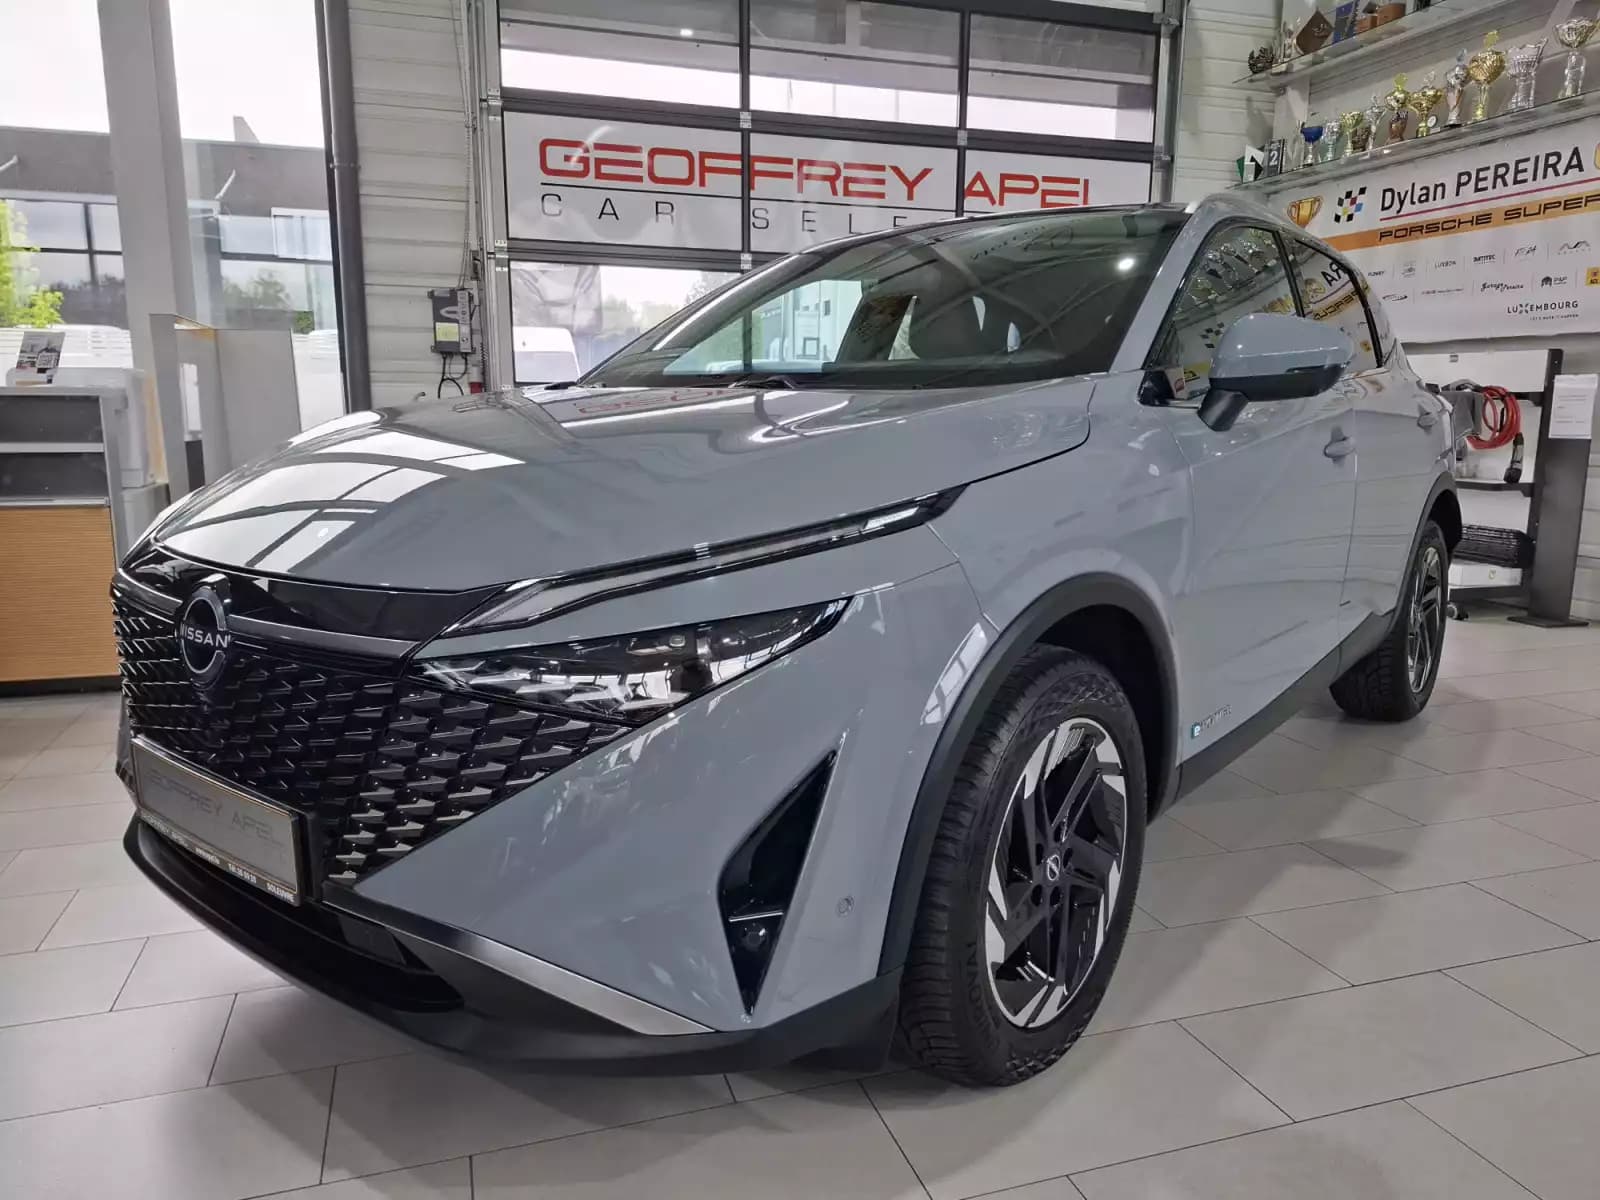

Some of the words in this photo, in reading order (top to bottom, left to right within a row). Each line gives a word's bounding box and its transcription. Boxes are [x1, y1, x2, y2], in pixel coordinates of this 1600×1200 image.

[540, 138, 932, 201] GEOFFREY
[1380, 180, 1447, 215] Dylan
[1455, 147, 1584, 197] PEREIRA
[540, 193, 674, 224] CAR
[1379, 212, 1493, 242] PORSCHE
[1507, 300, 1579, 315] LUXEMBOURG
[180, 624, 231, 650] NISSAN
